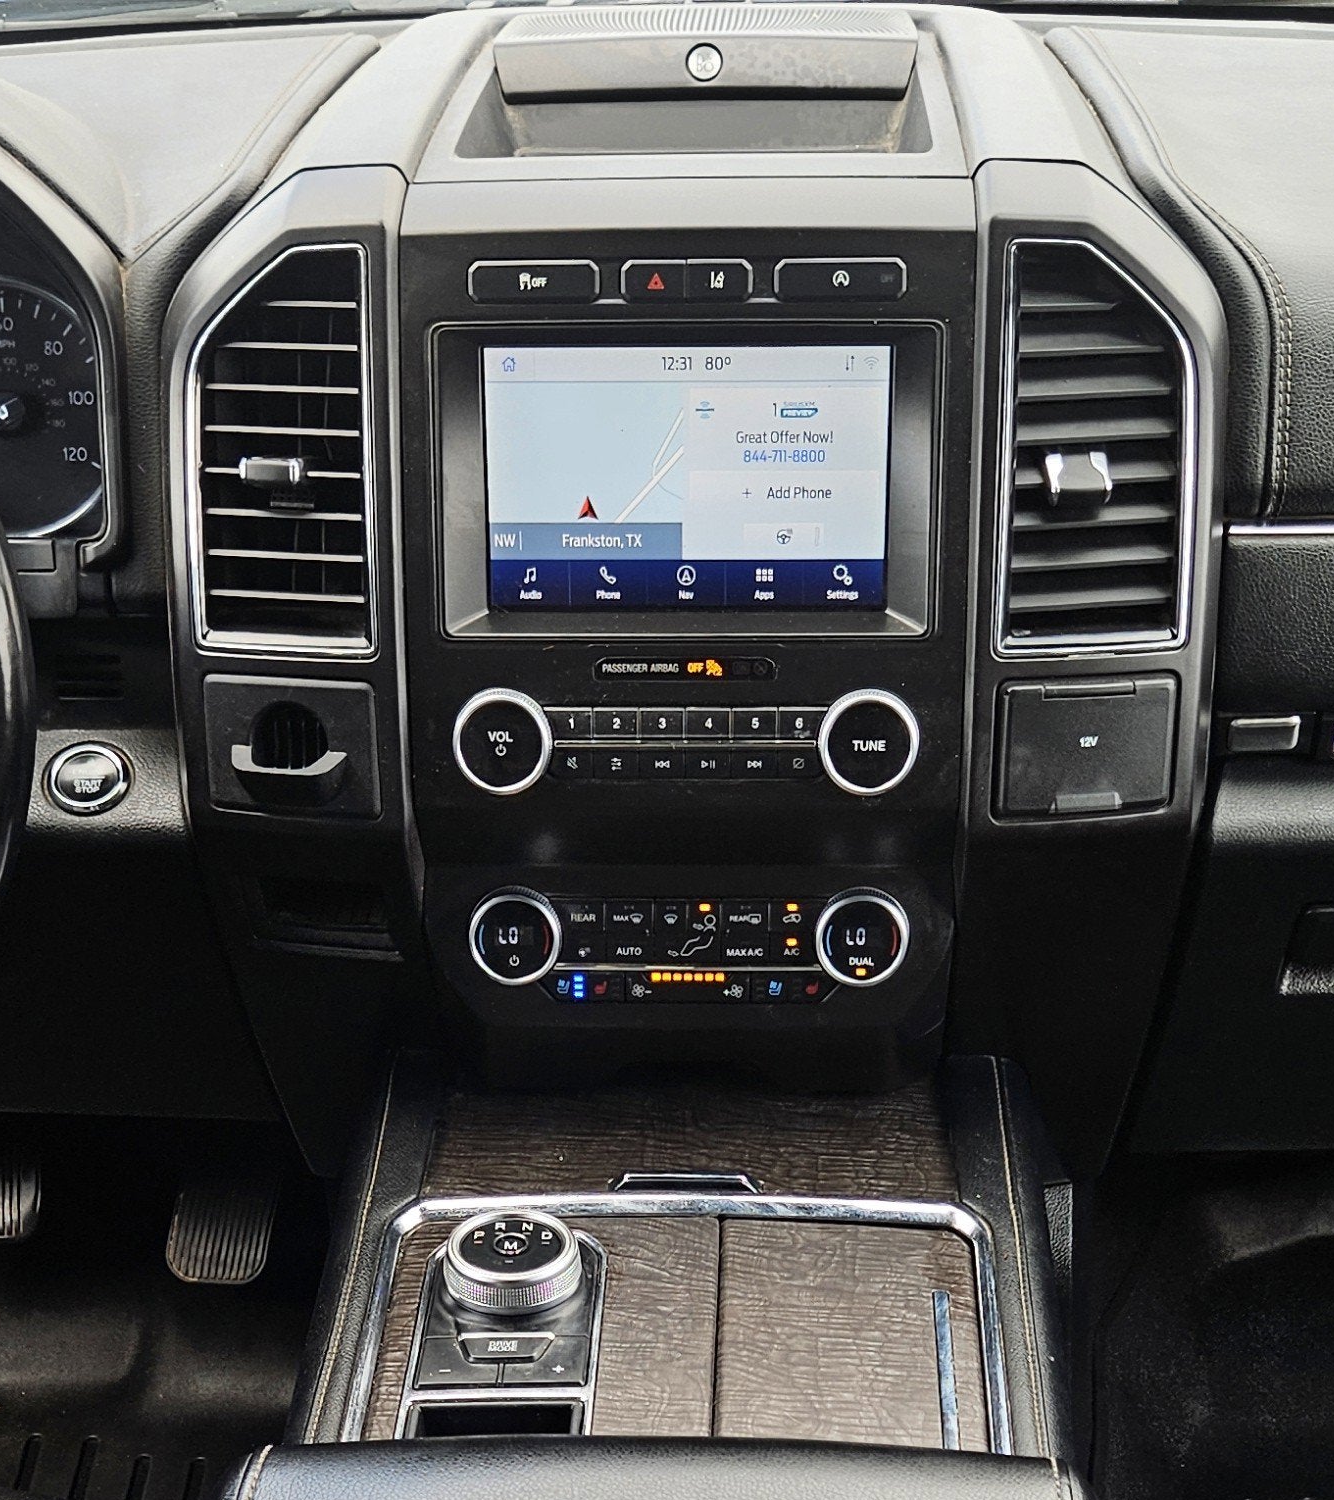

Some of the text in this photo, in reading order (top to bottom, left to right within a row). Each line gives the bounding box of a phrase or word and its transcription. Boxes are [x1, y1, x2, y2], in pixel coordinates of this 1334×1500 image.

[531, 276, 548, 288] OFF
[43, 340, 63, 356] 80
[661, 356, 693, 371] 12:31
[68, 390, 95, 405] 100
[736, 430, 834, 444] Great Offer Now!
[62, 446, 88, 462] 120
[743, 449, 827, 463] 844-711-8800
[766, 486, 833, 499] Add Phone
[493, 533, 516, 549] NW
[561, 533, 643, 550] Frankston, TX
[519, 589, 543, 600] Audio
[595, 589, 621, 600] Phone
[678, 589, 695, 600] Nav
[753, 589, 775, 601] Apps
[826, 589, 859, 602] Settings
[601, 662, 705, 674] PASSENGER AIRBAG OFF
[567, 717, 575, 730] 1
[611, 717, 622, 730] 2
[657, 717, 667, 729] 3
[704, 717, 713, 730] 4
[751, 717, 760, 730] 5
[794, 717, 804, 729] 6
[487, 731, 514, 743] VOL
[1079, 735, 1100, 748] 12V
[851, 739, 887, 752] TUNE
[73, 779, 104, 788] START
[74, 786, 100, 794] STOP
[570, 913, 597, 923] REAR
[612, 914, 630, 923] MAX
[729, 914, 749, 923] REAR
[845, 926, 867, 946] LO
[615, 946, 643, 956] AUTO
[726, 948, 764, 957] MAX A/C
[783, 947, 801, 957] A/C
[848, 956, 875, 967] DUAL
[494, 1222, 506, 1231] R
[521, 1222, 534, 1231] N
[473, 1231, 485, 1240] P
[541, 1231, 553, 1240] D
[504, 1241, 518, 1250] M
